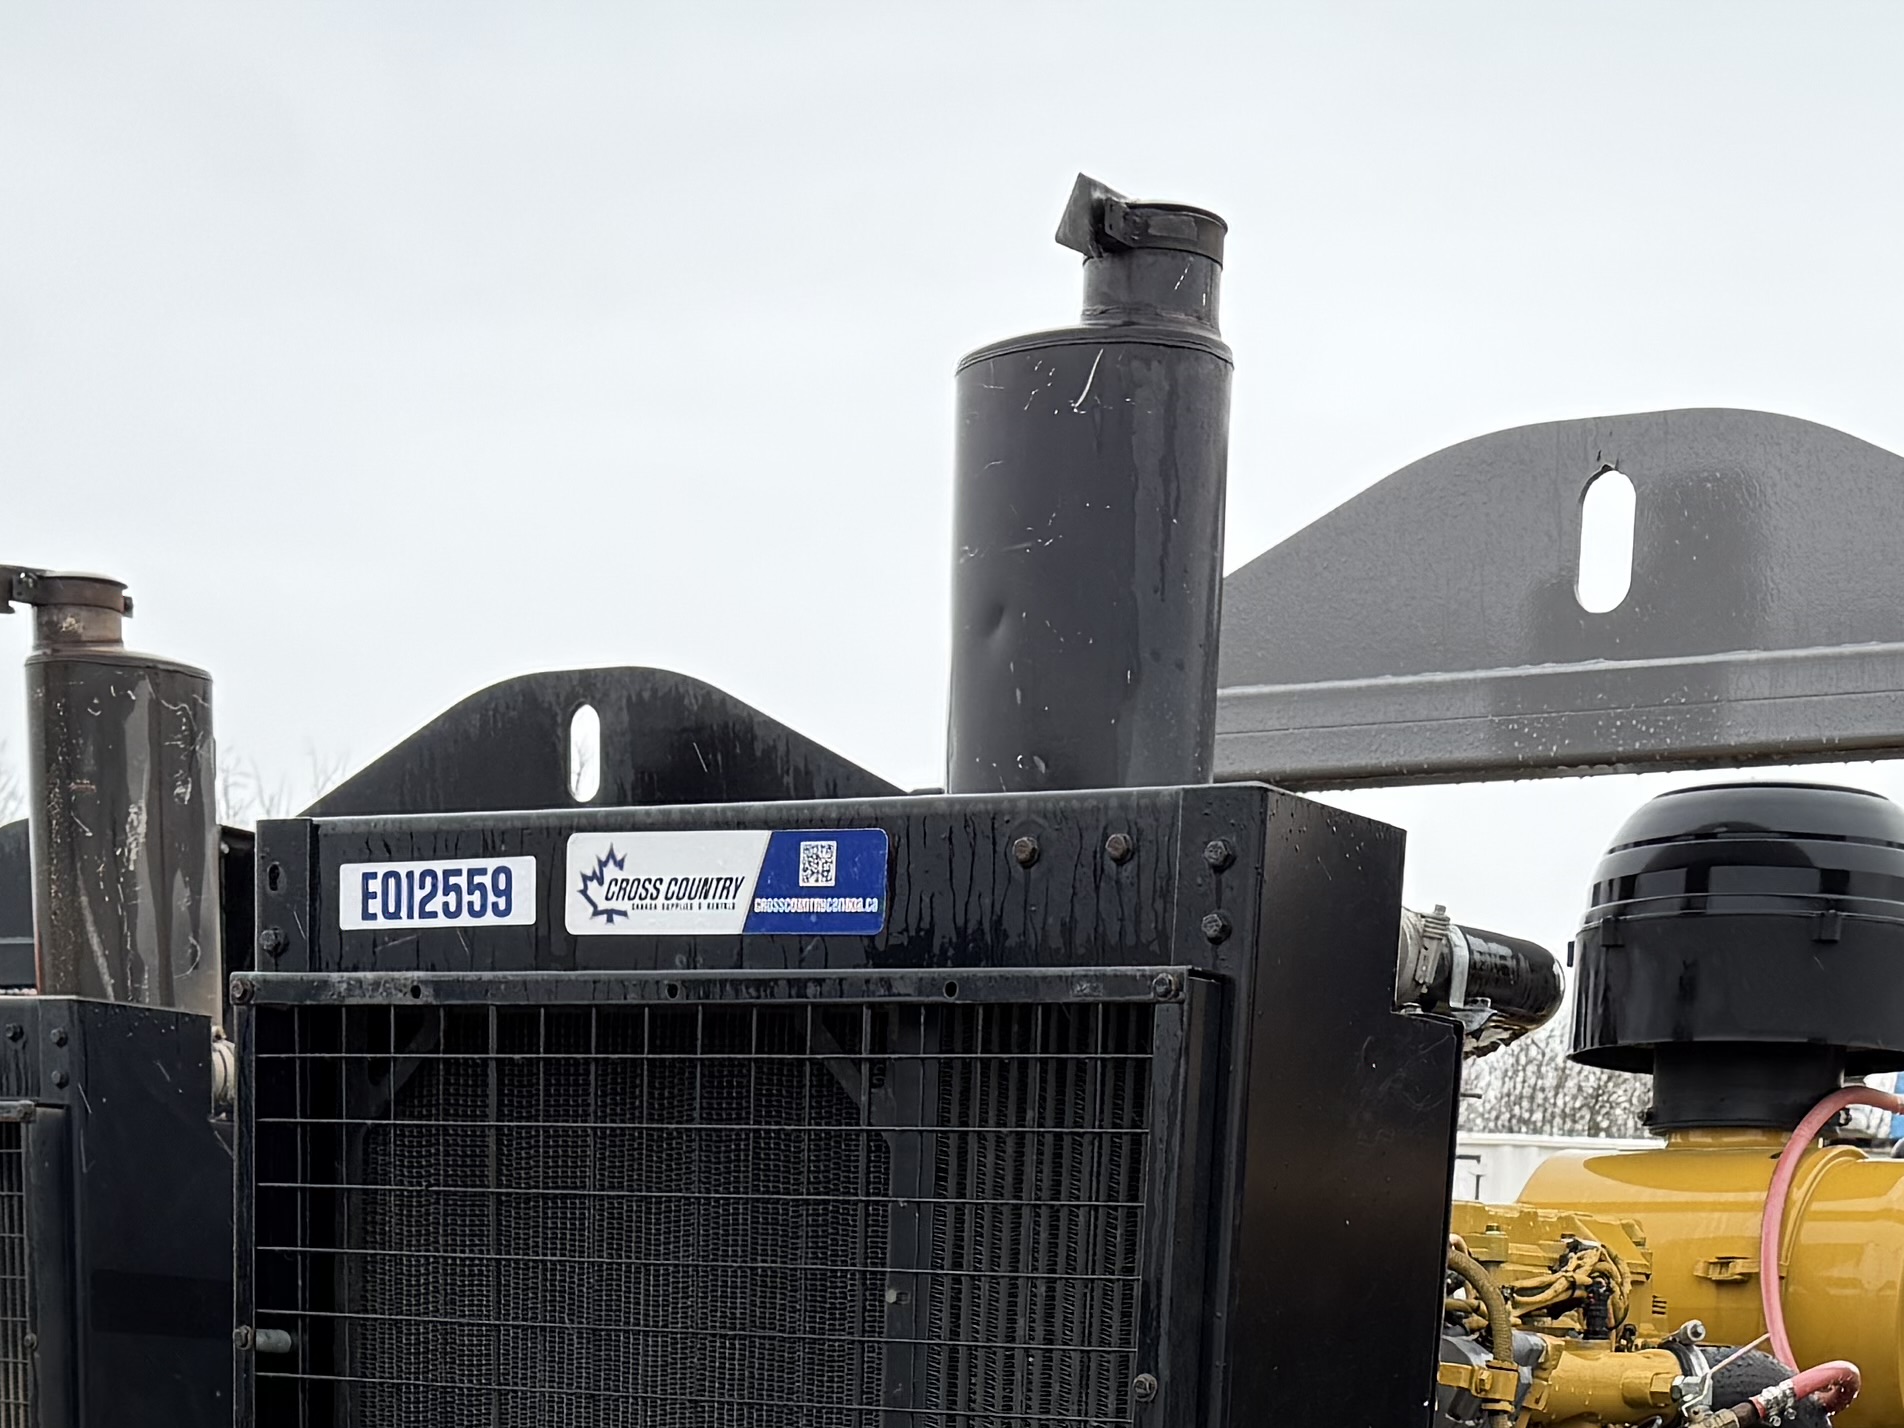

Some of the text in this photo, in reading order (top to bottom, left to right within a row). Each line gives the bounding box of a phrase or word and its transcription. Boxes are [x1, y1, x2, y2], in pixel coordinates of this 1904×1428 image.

[361, 866, 514, 922] EQ12559
[605, 876, 746, 901] CROSS COUNTRY
